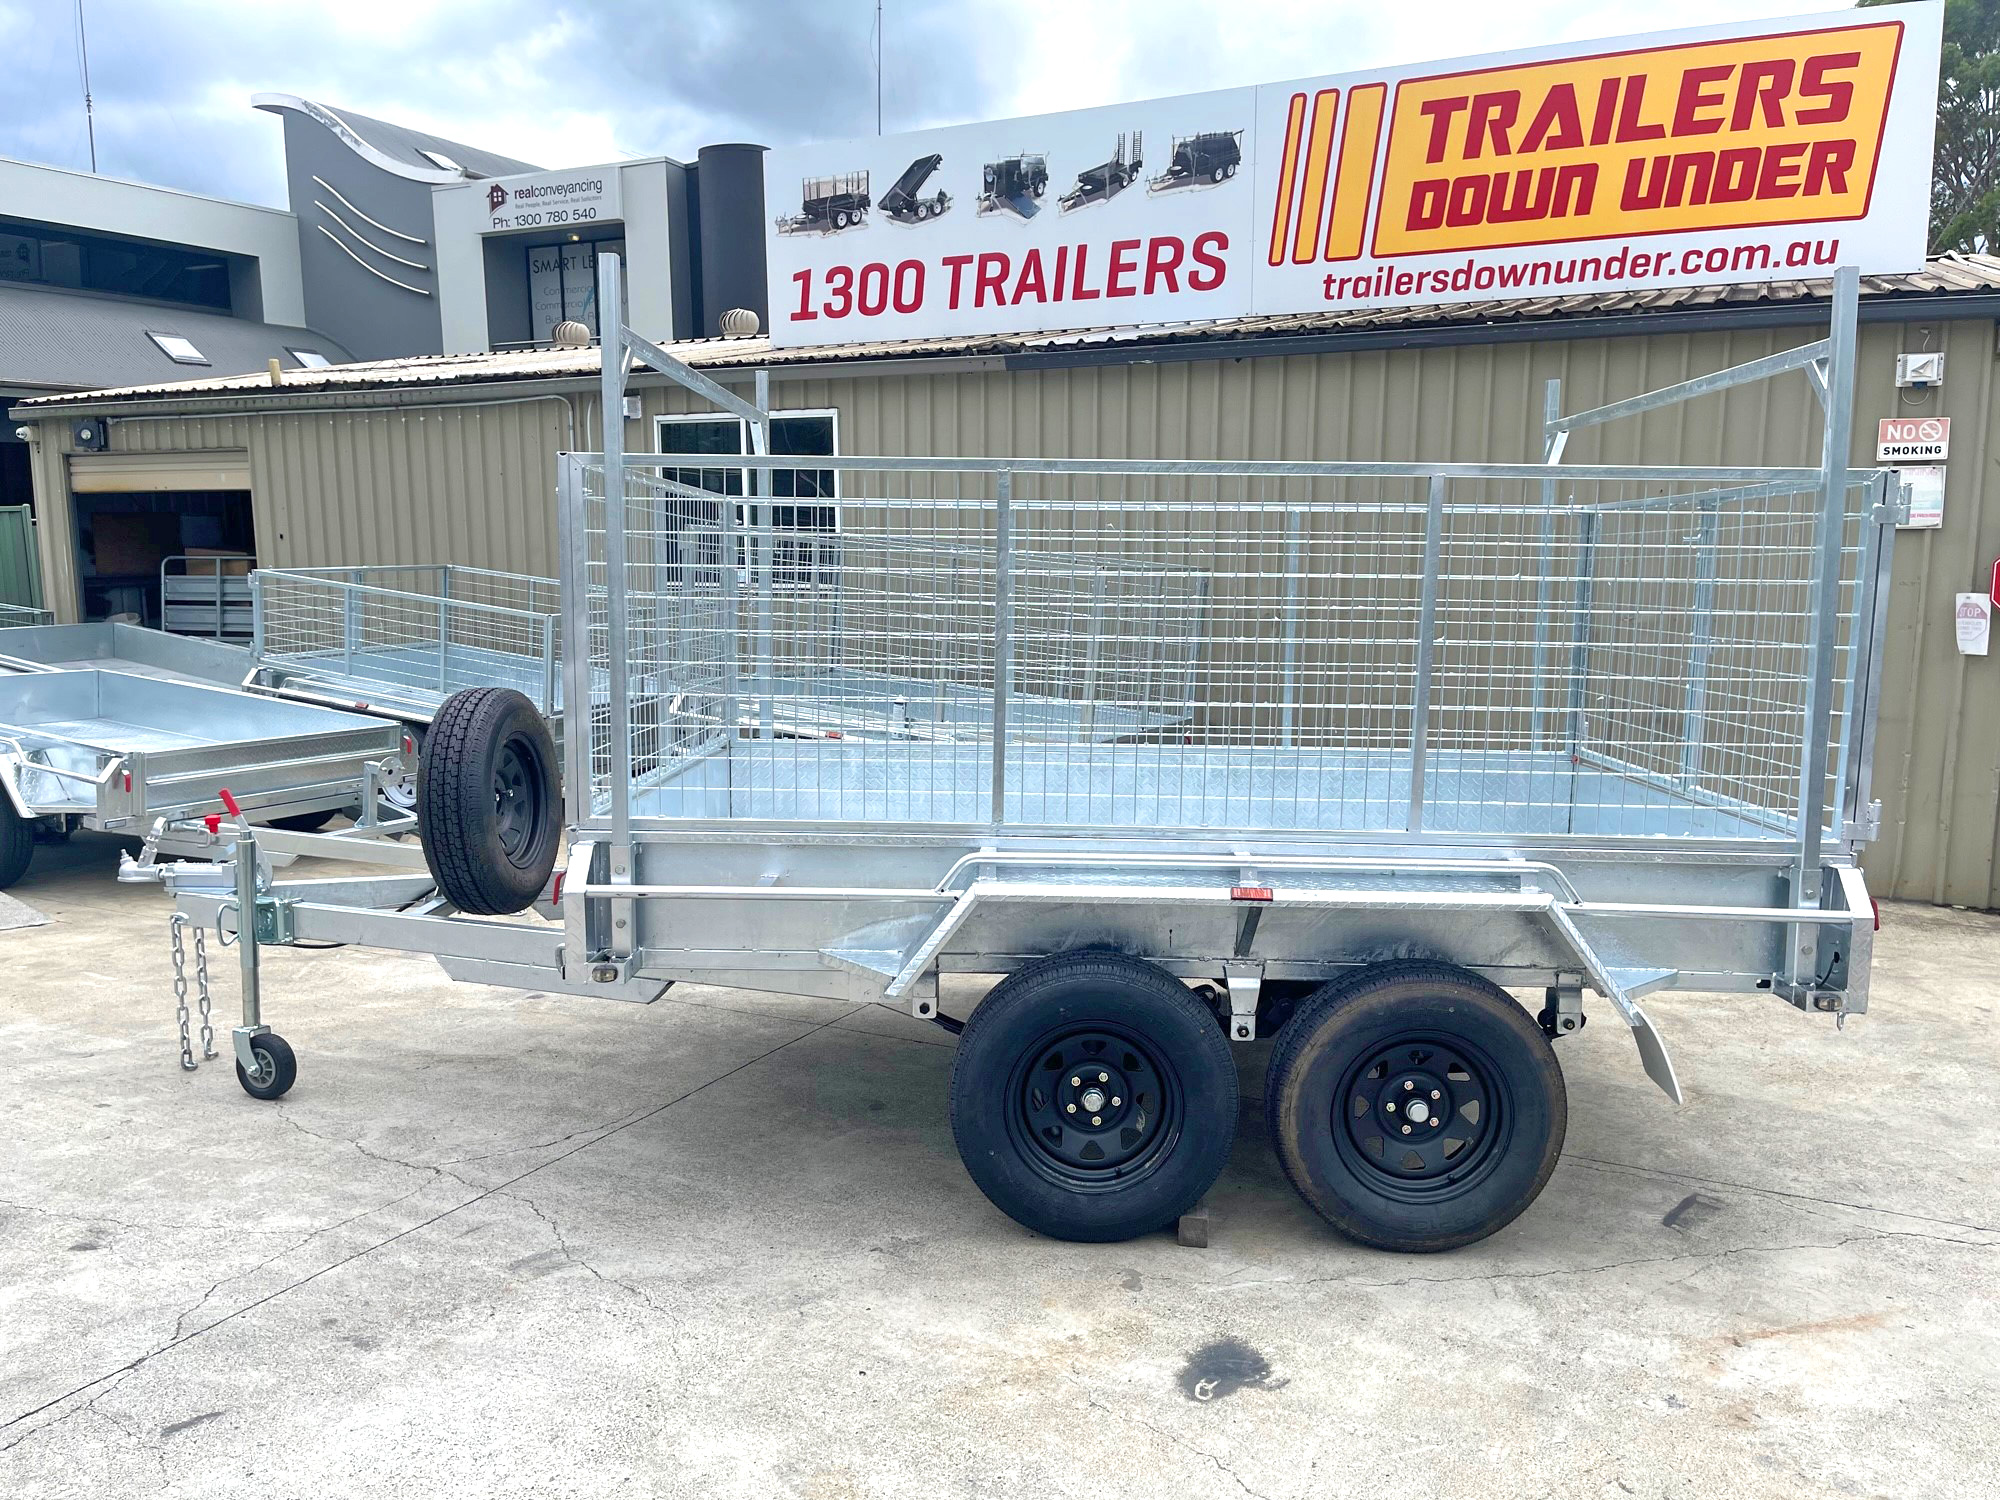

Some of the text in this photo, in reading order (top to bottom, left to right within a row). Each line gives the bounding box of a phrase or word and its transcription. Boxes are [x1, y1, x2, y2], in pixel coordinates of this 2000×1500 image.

[1420, 51, 1862, 164] TRAILERS
[514, 178, 603, 200] realconveyancing
[1404, 138, 1857, 232] DOWN UNDER
[493, 206, 596, 229] Ph: 1300 780 540
[532, 256, 576, 274] SMART
[791, 231, 1229, 321] 1300 TRAILERS
[1323, 239, 1839, 300] trailersdownunder.com.au
[1887, 424, 1916, 440] NO
[1884, 446, 1942, 455] SMOKING
[1960, 607, 1981, 617] STOP
